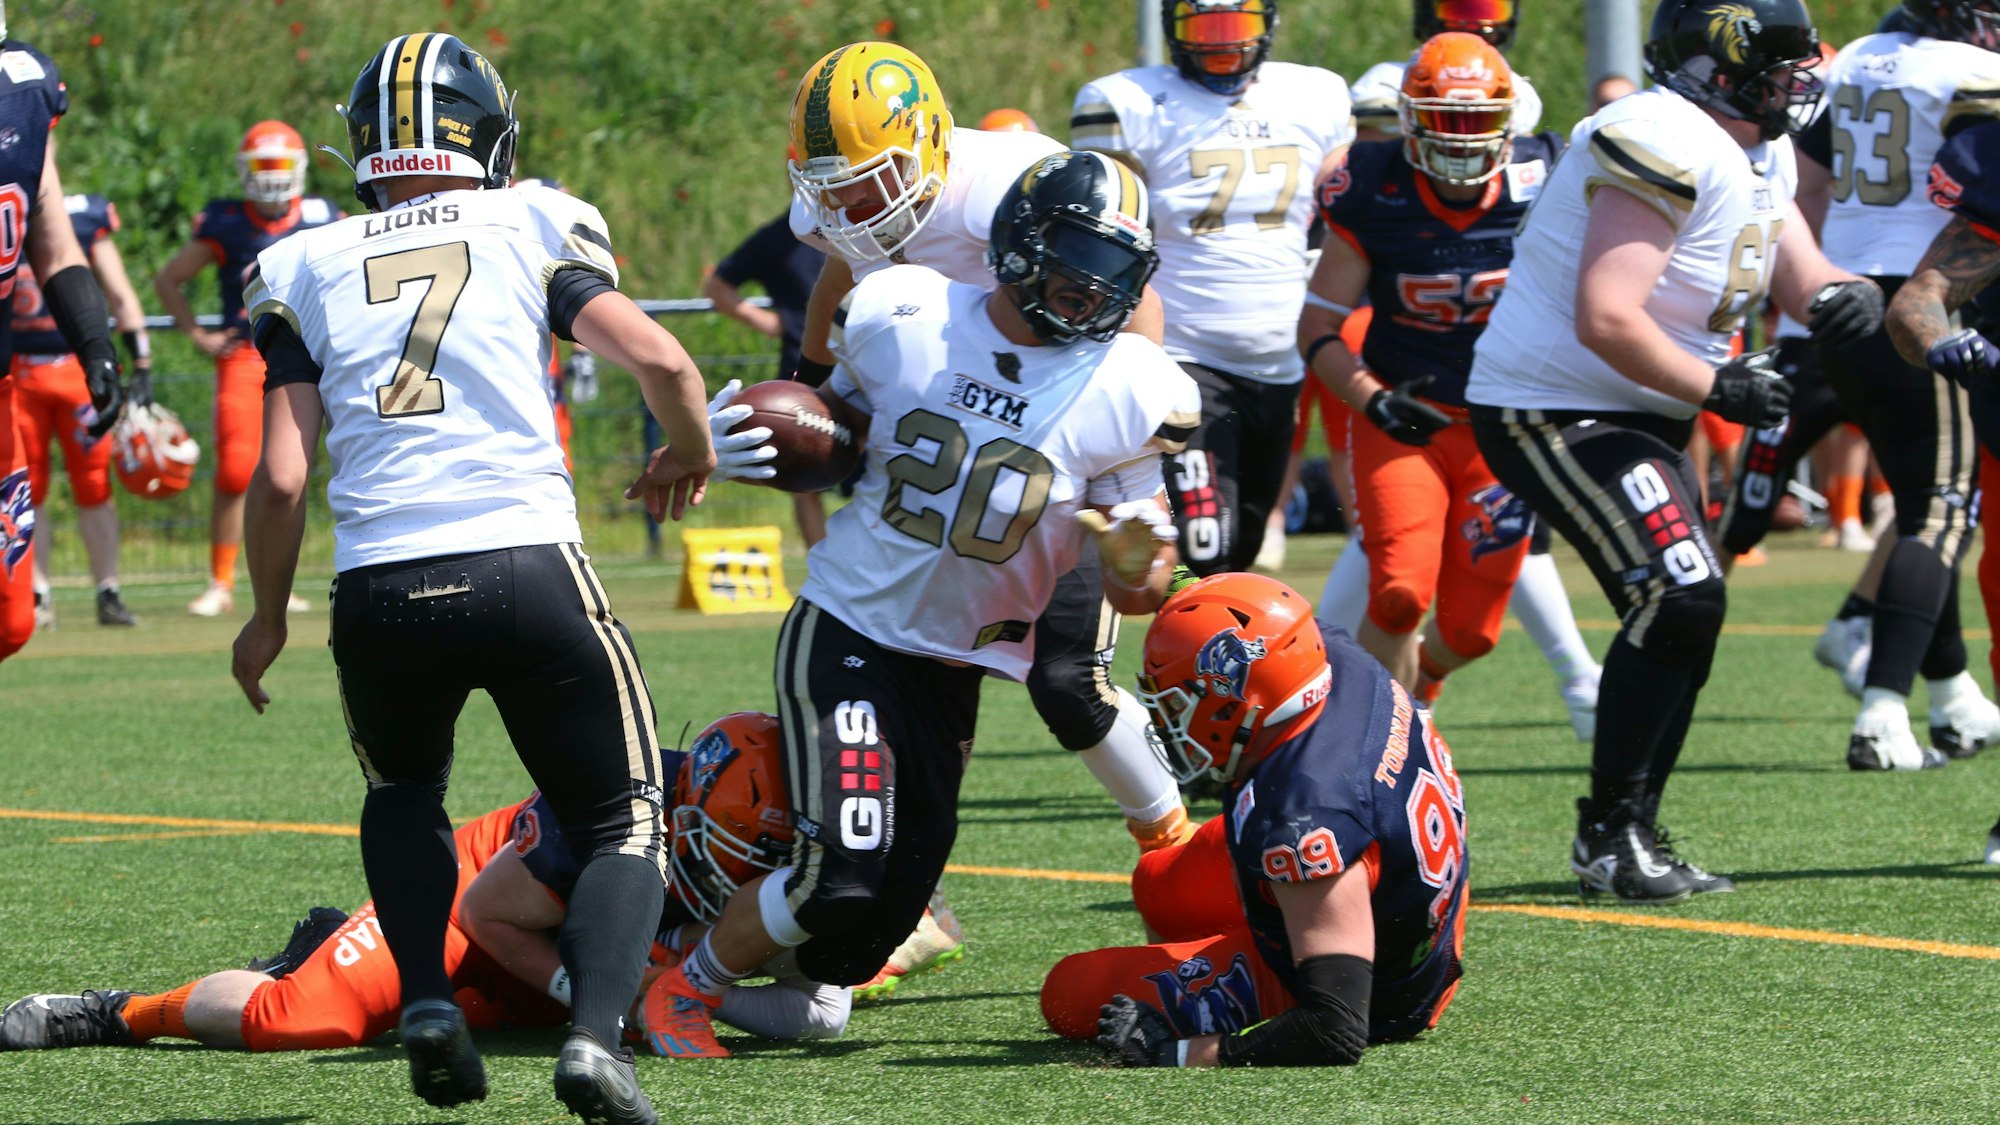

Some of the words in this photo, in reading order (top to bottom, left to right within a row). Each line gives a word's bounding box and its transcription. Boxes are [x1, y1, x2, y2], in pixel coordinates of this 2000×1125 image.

[360, 124, 371, 146] 7
[461, 123, 471, 134] IT
[1833, 85, 1911, 207] 63
[371, 154, 451, 174] Riddell
[1188, 145, 1300, 236] 77
[363, 204, 459, 239] LIONS
[364, 241, 470, 418] 7
[963, 382, 1029, 428] GYM
[881, 408, 1055, 563] 20
[1261, 826, 1345, 882] 99
